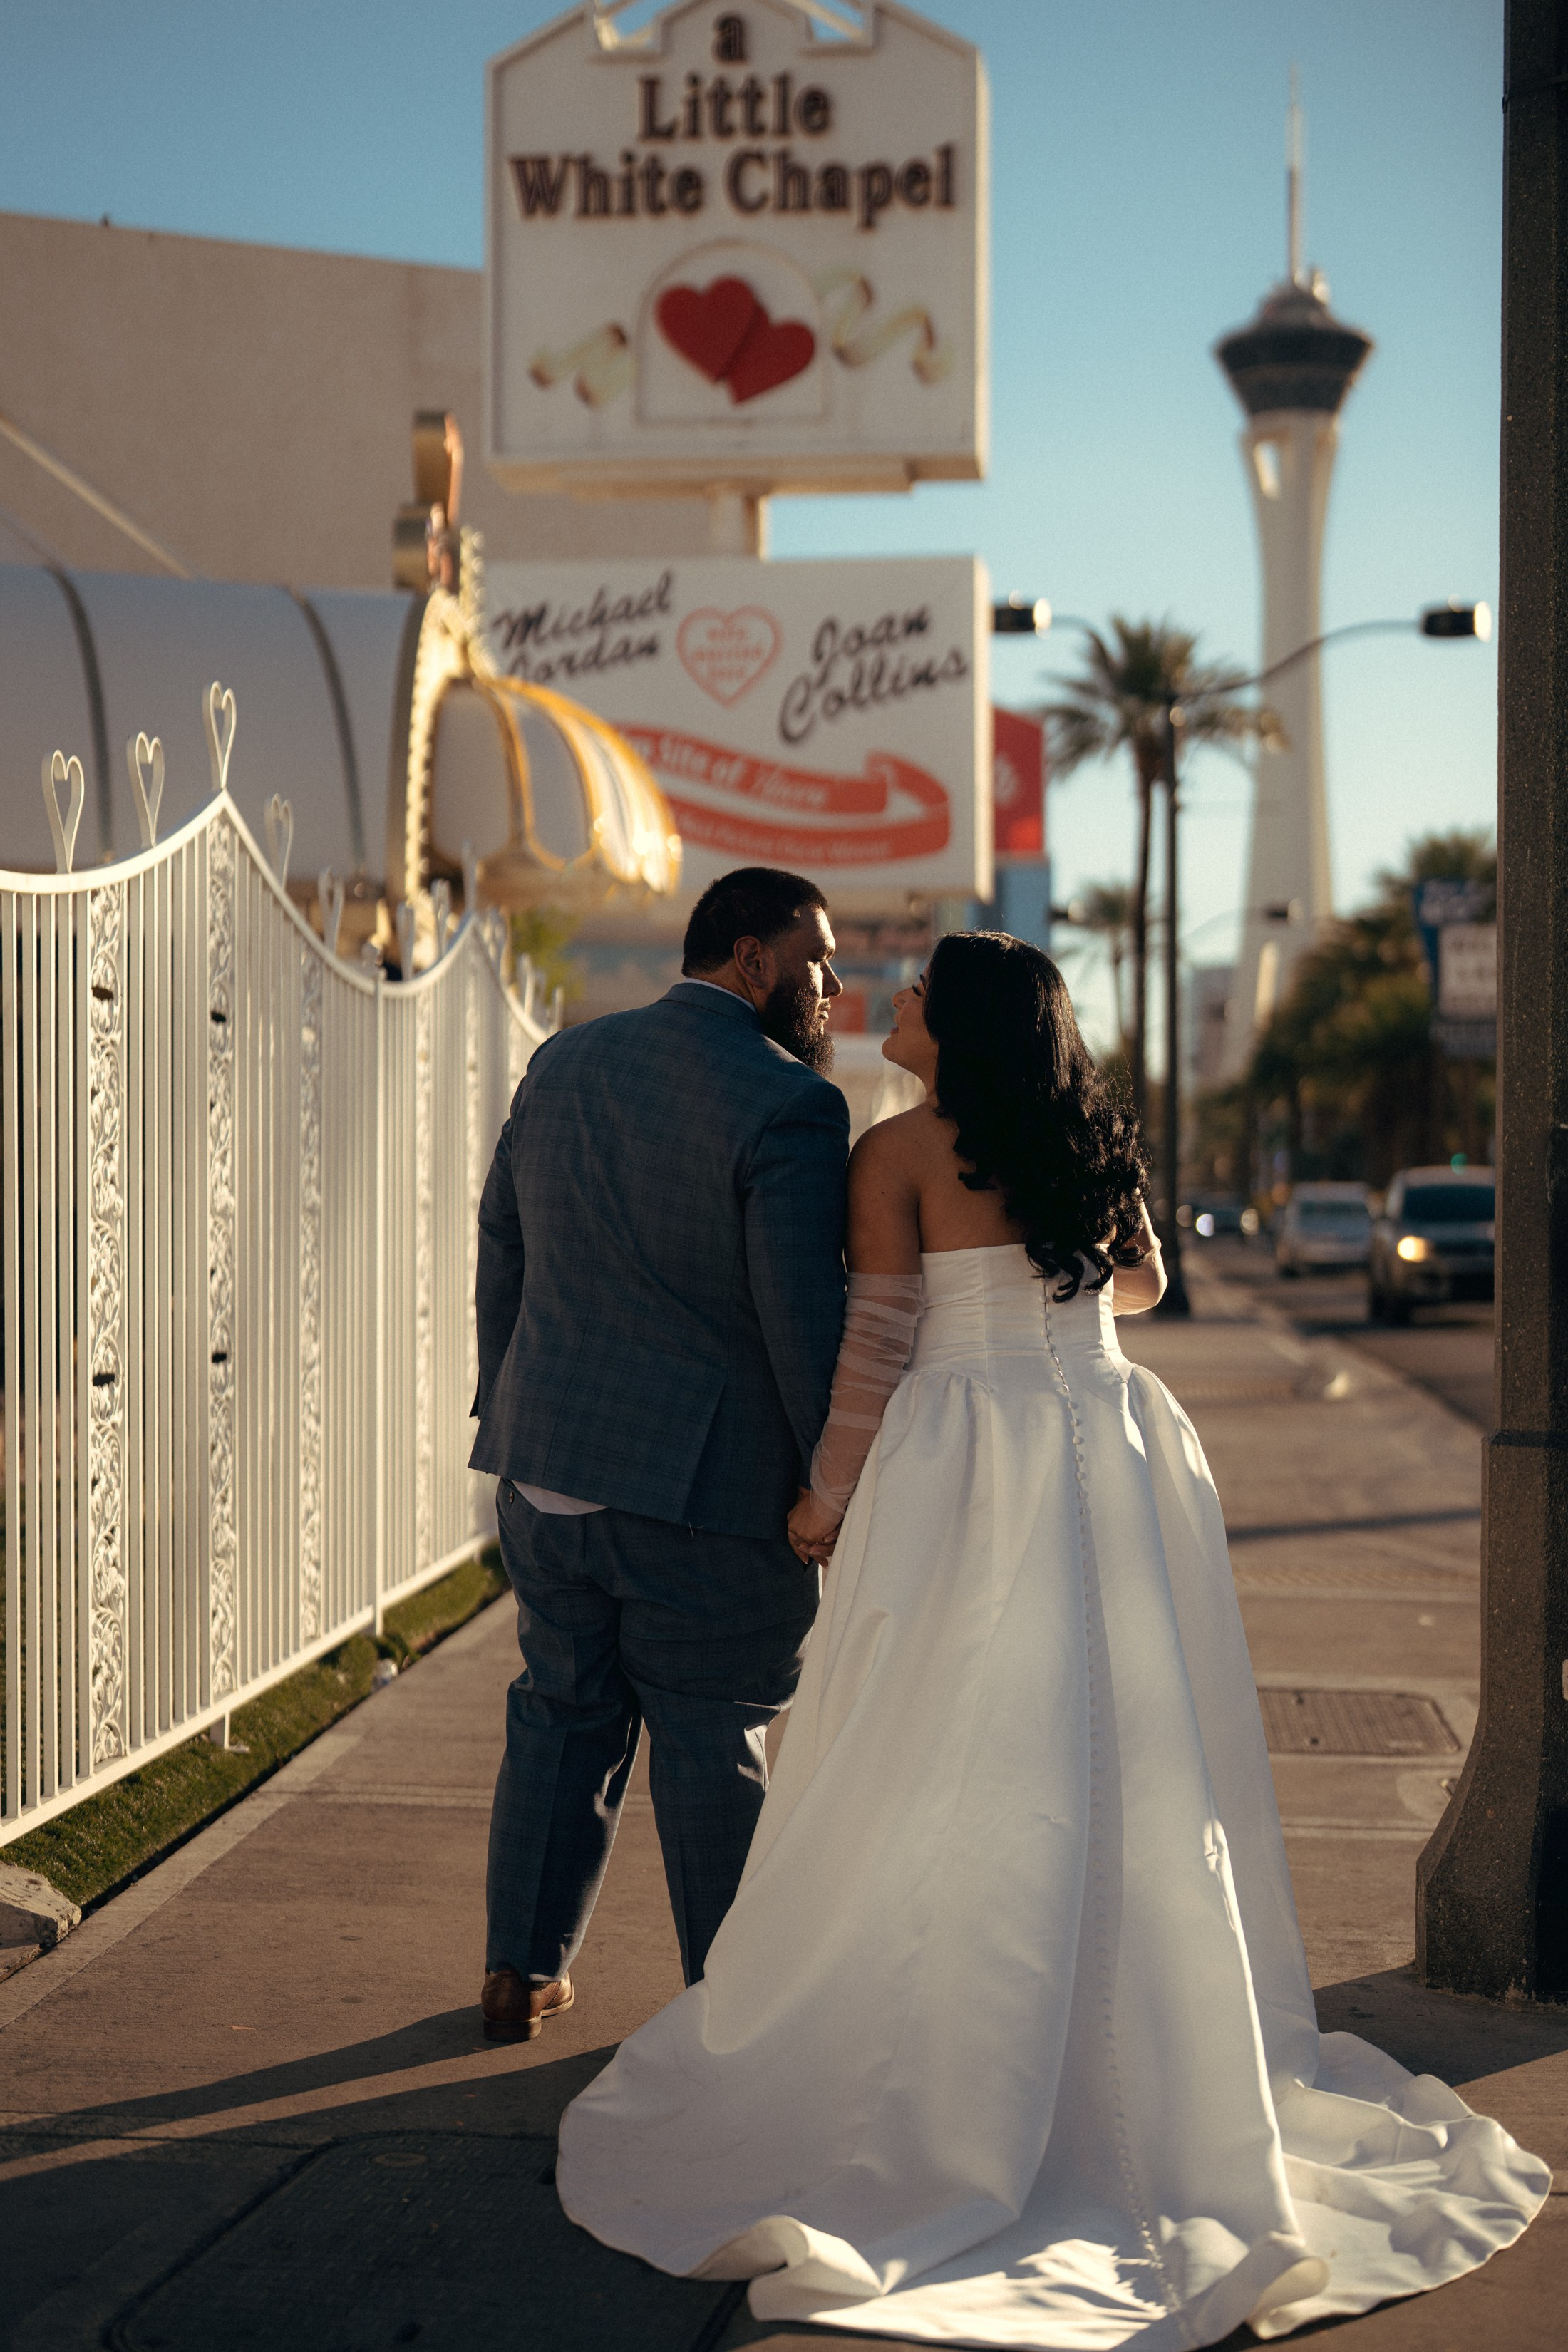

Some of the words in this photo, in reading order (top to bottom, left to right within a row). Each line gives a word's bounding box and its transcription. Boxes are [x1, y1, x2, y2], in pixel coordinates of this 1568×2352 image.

[713, 13, 747, 63] a
[639, 71, 832, 142] Little
[509, 150, 704, 220] White
[723, 145, 956, 232] Chapel
[490, 568, 672, 651] Michael
[813, 606, 929, 691] Joan
[778, 646, 968, 744] Collins
